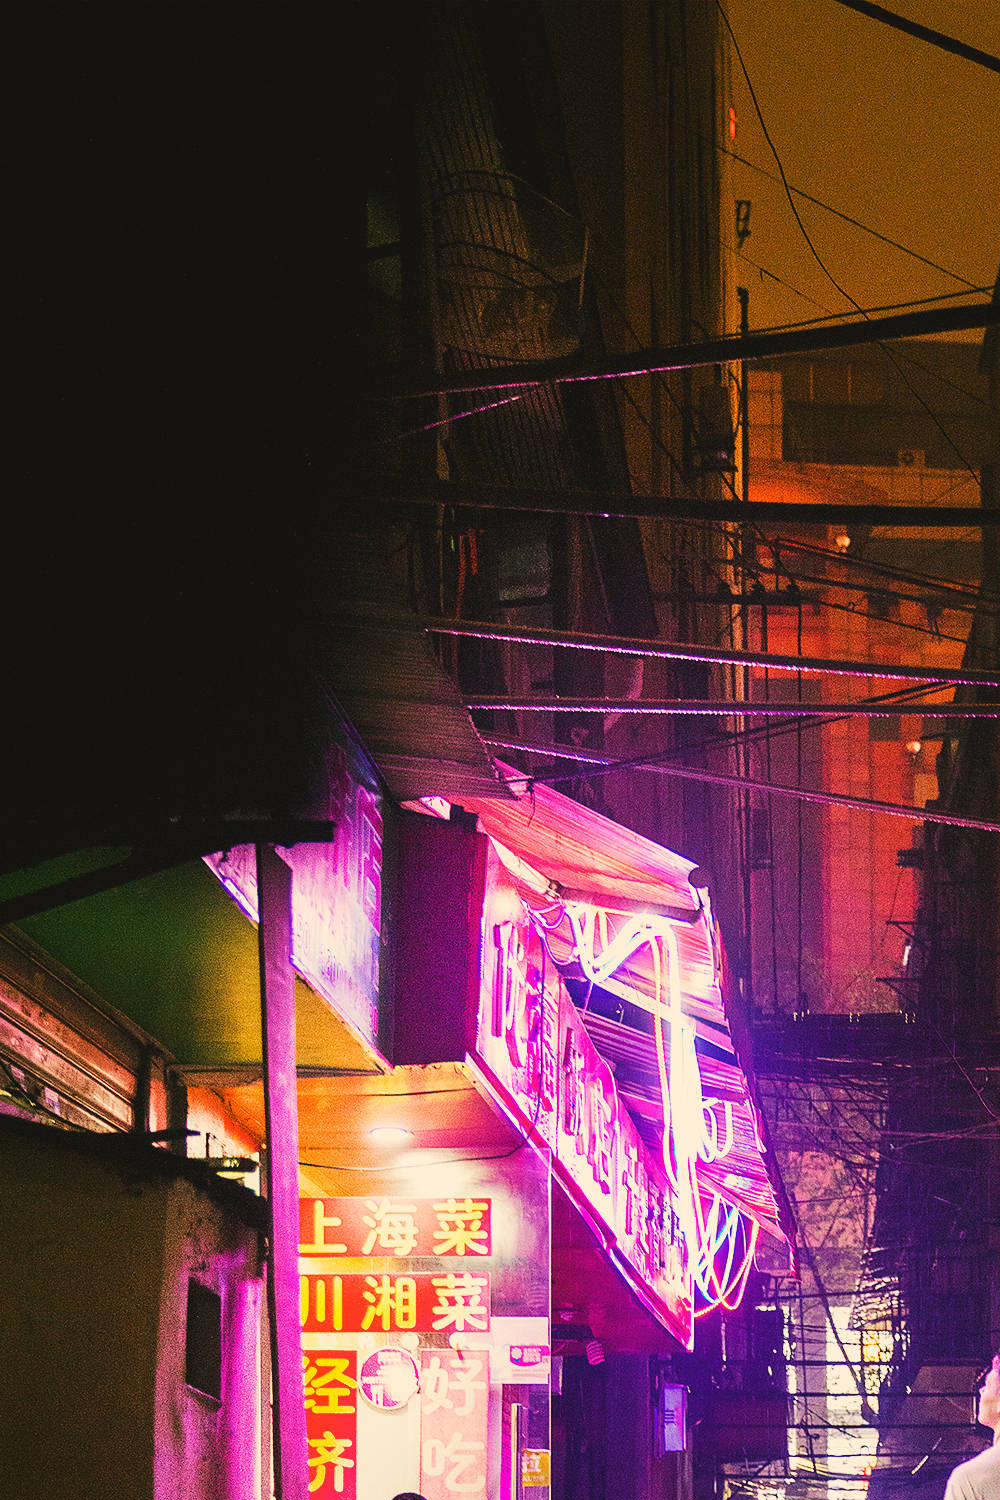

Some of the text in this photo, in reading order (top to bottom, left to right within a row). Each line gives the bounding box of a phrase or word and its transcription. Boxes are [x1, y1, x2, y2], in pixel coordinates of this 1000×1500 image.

[298, 1199, 489, 1256] 上海菜
[300, 1274, 488, 1331] 川湘菜
